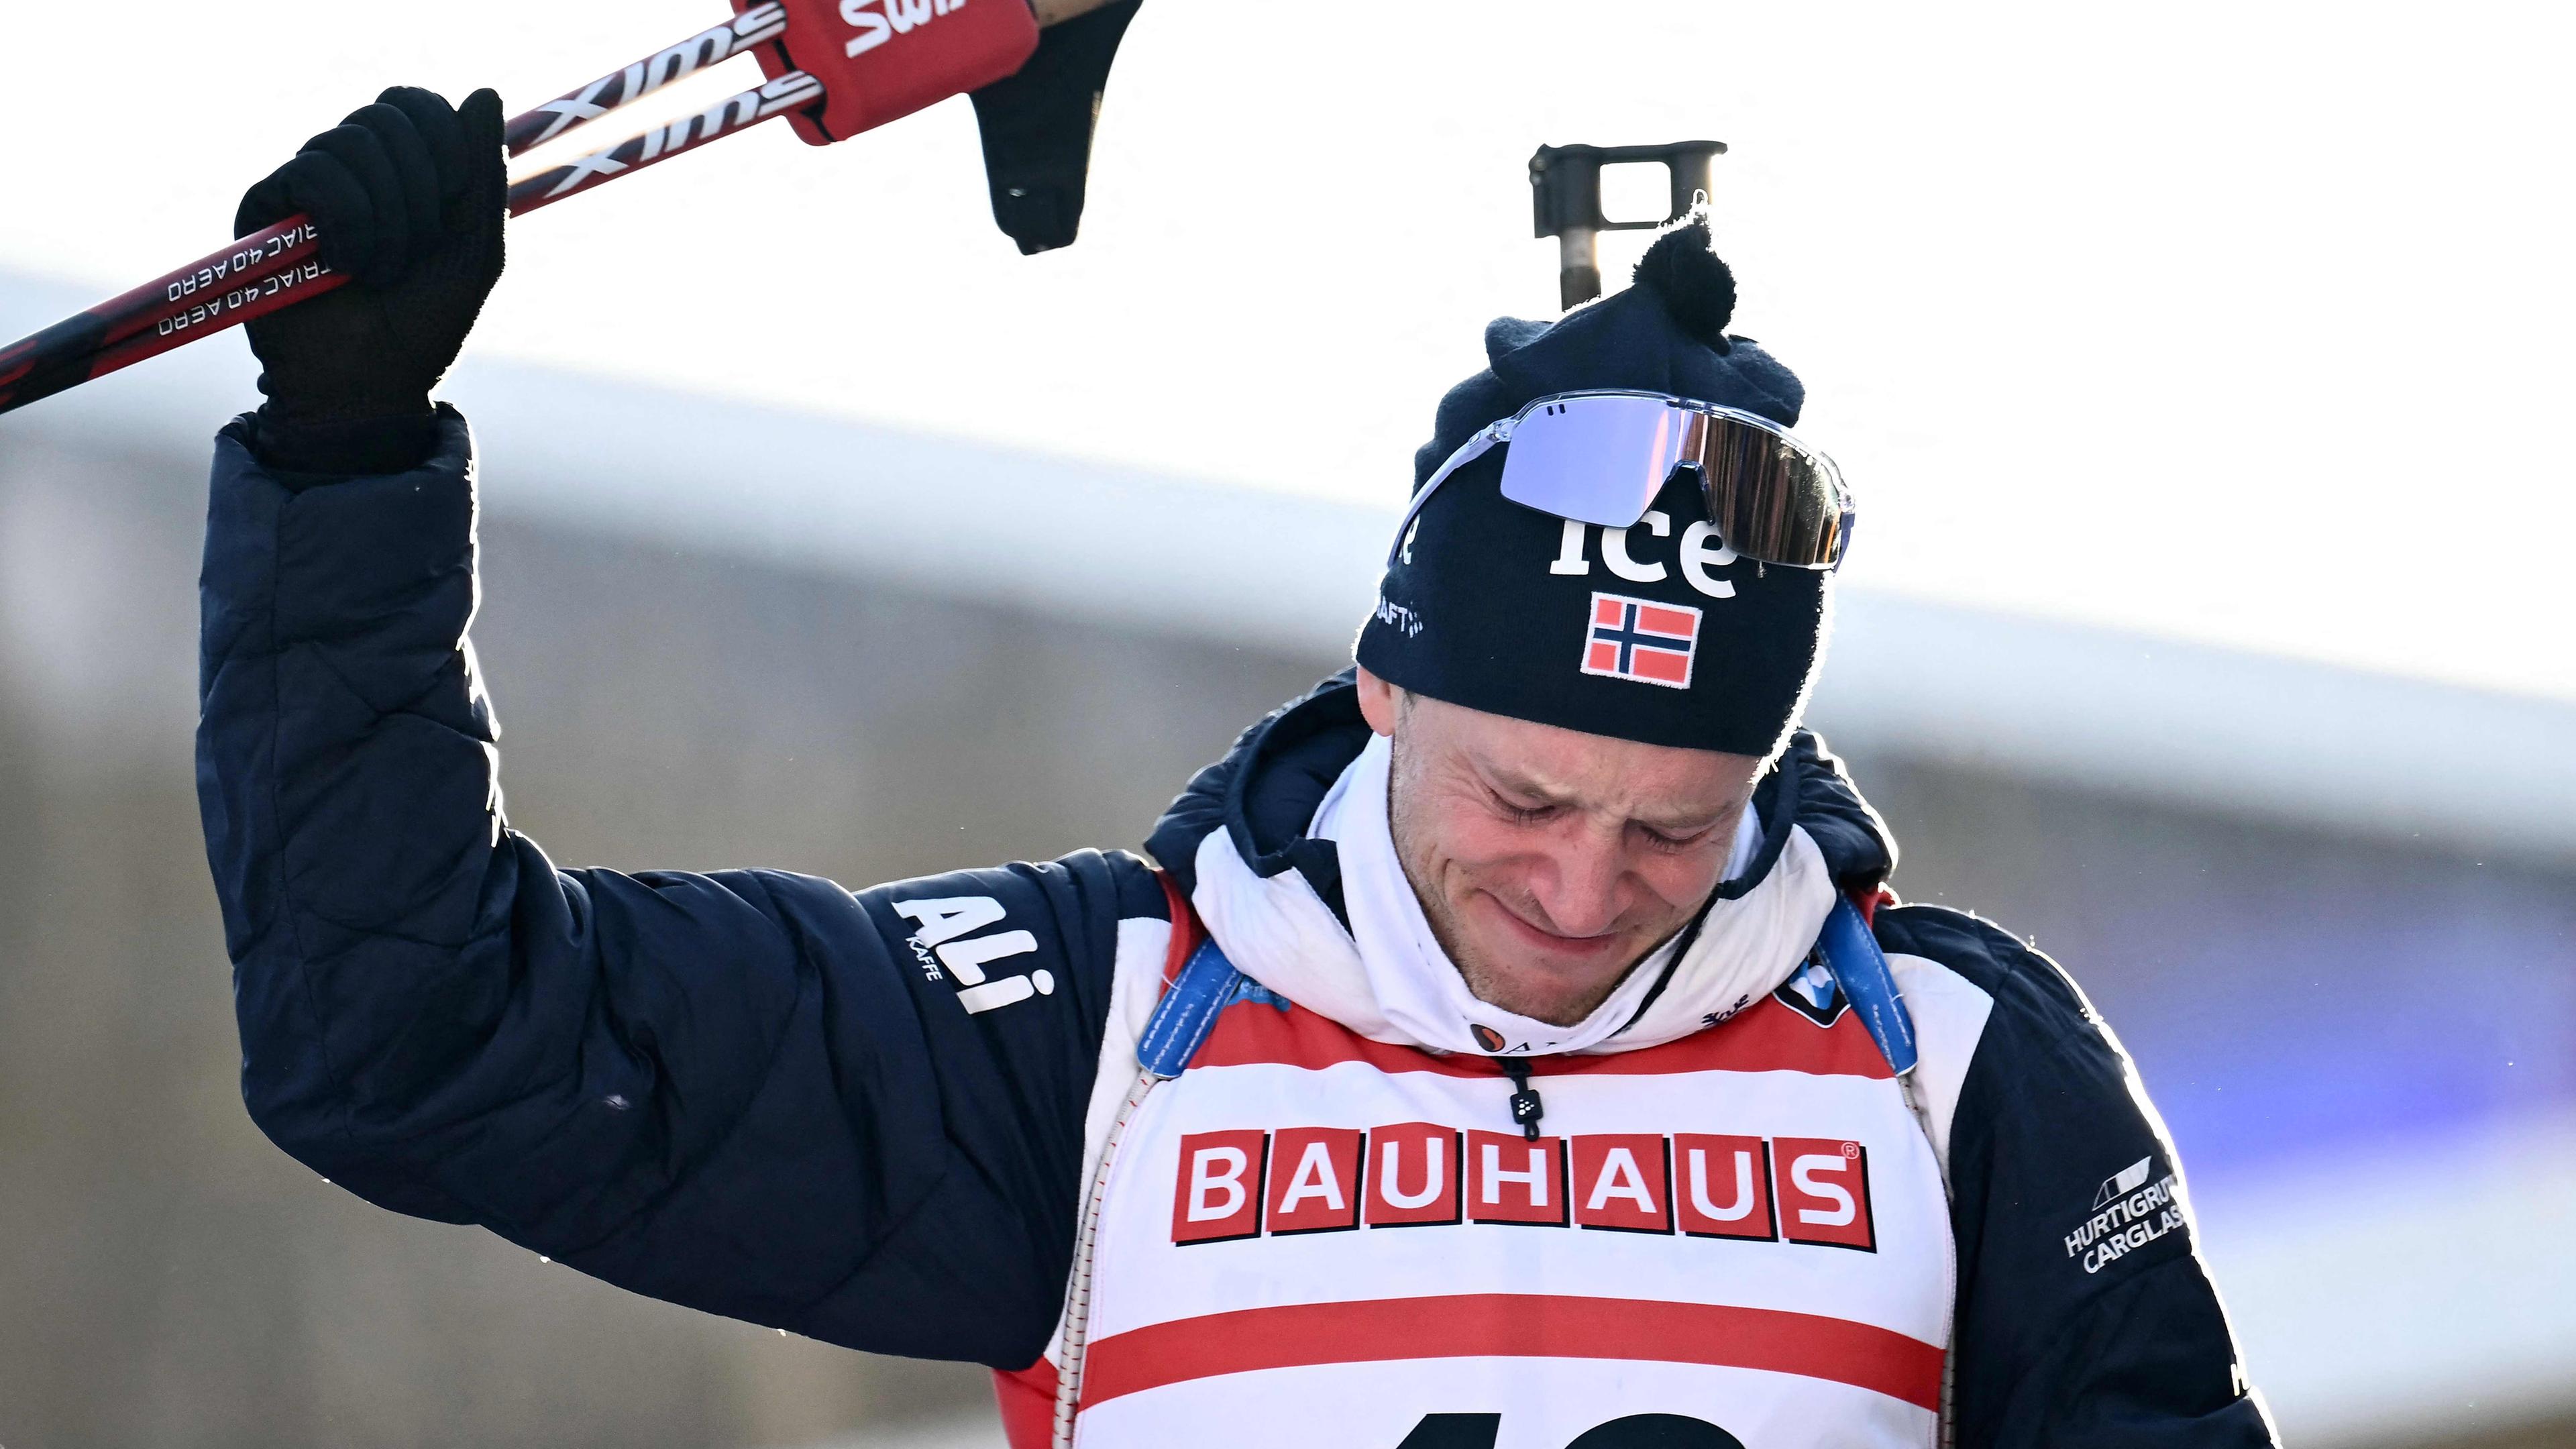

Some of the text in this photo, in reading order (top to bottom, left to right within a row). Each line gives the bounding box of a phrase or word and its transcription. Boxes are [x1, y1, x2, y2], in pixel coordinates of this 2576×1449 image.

[232, 248, 264, 272] 4.0
[168, 260, 227, 302] AERO
[227, 288, 260, 309] 4.0
[158, 298, 221, 336] AERO
[905, 935, 943, 983] KAFFE
